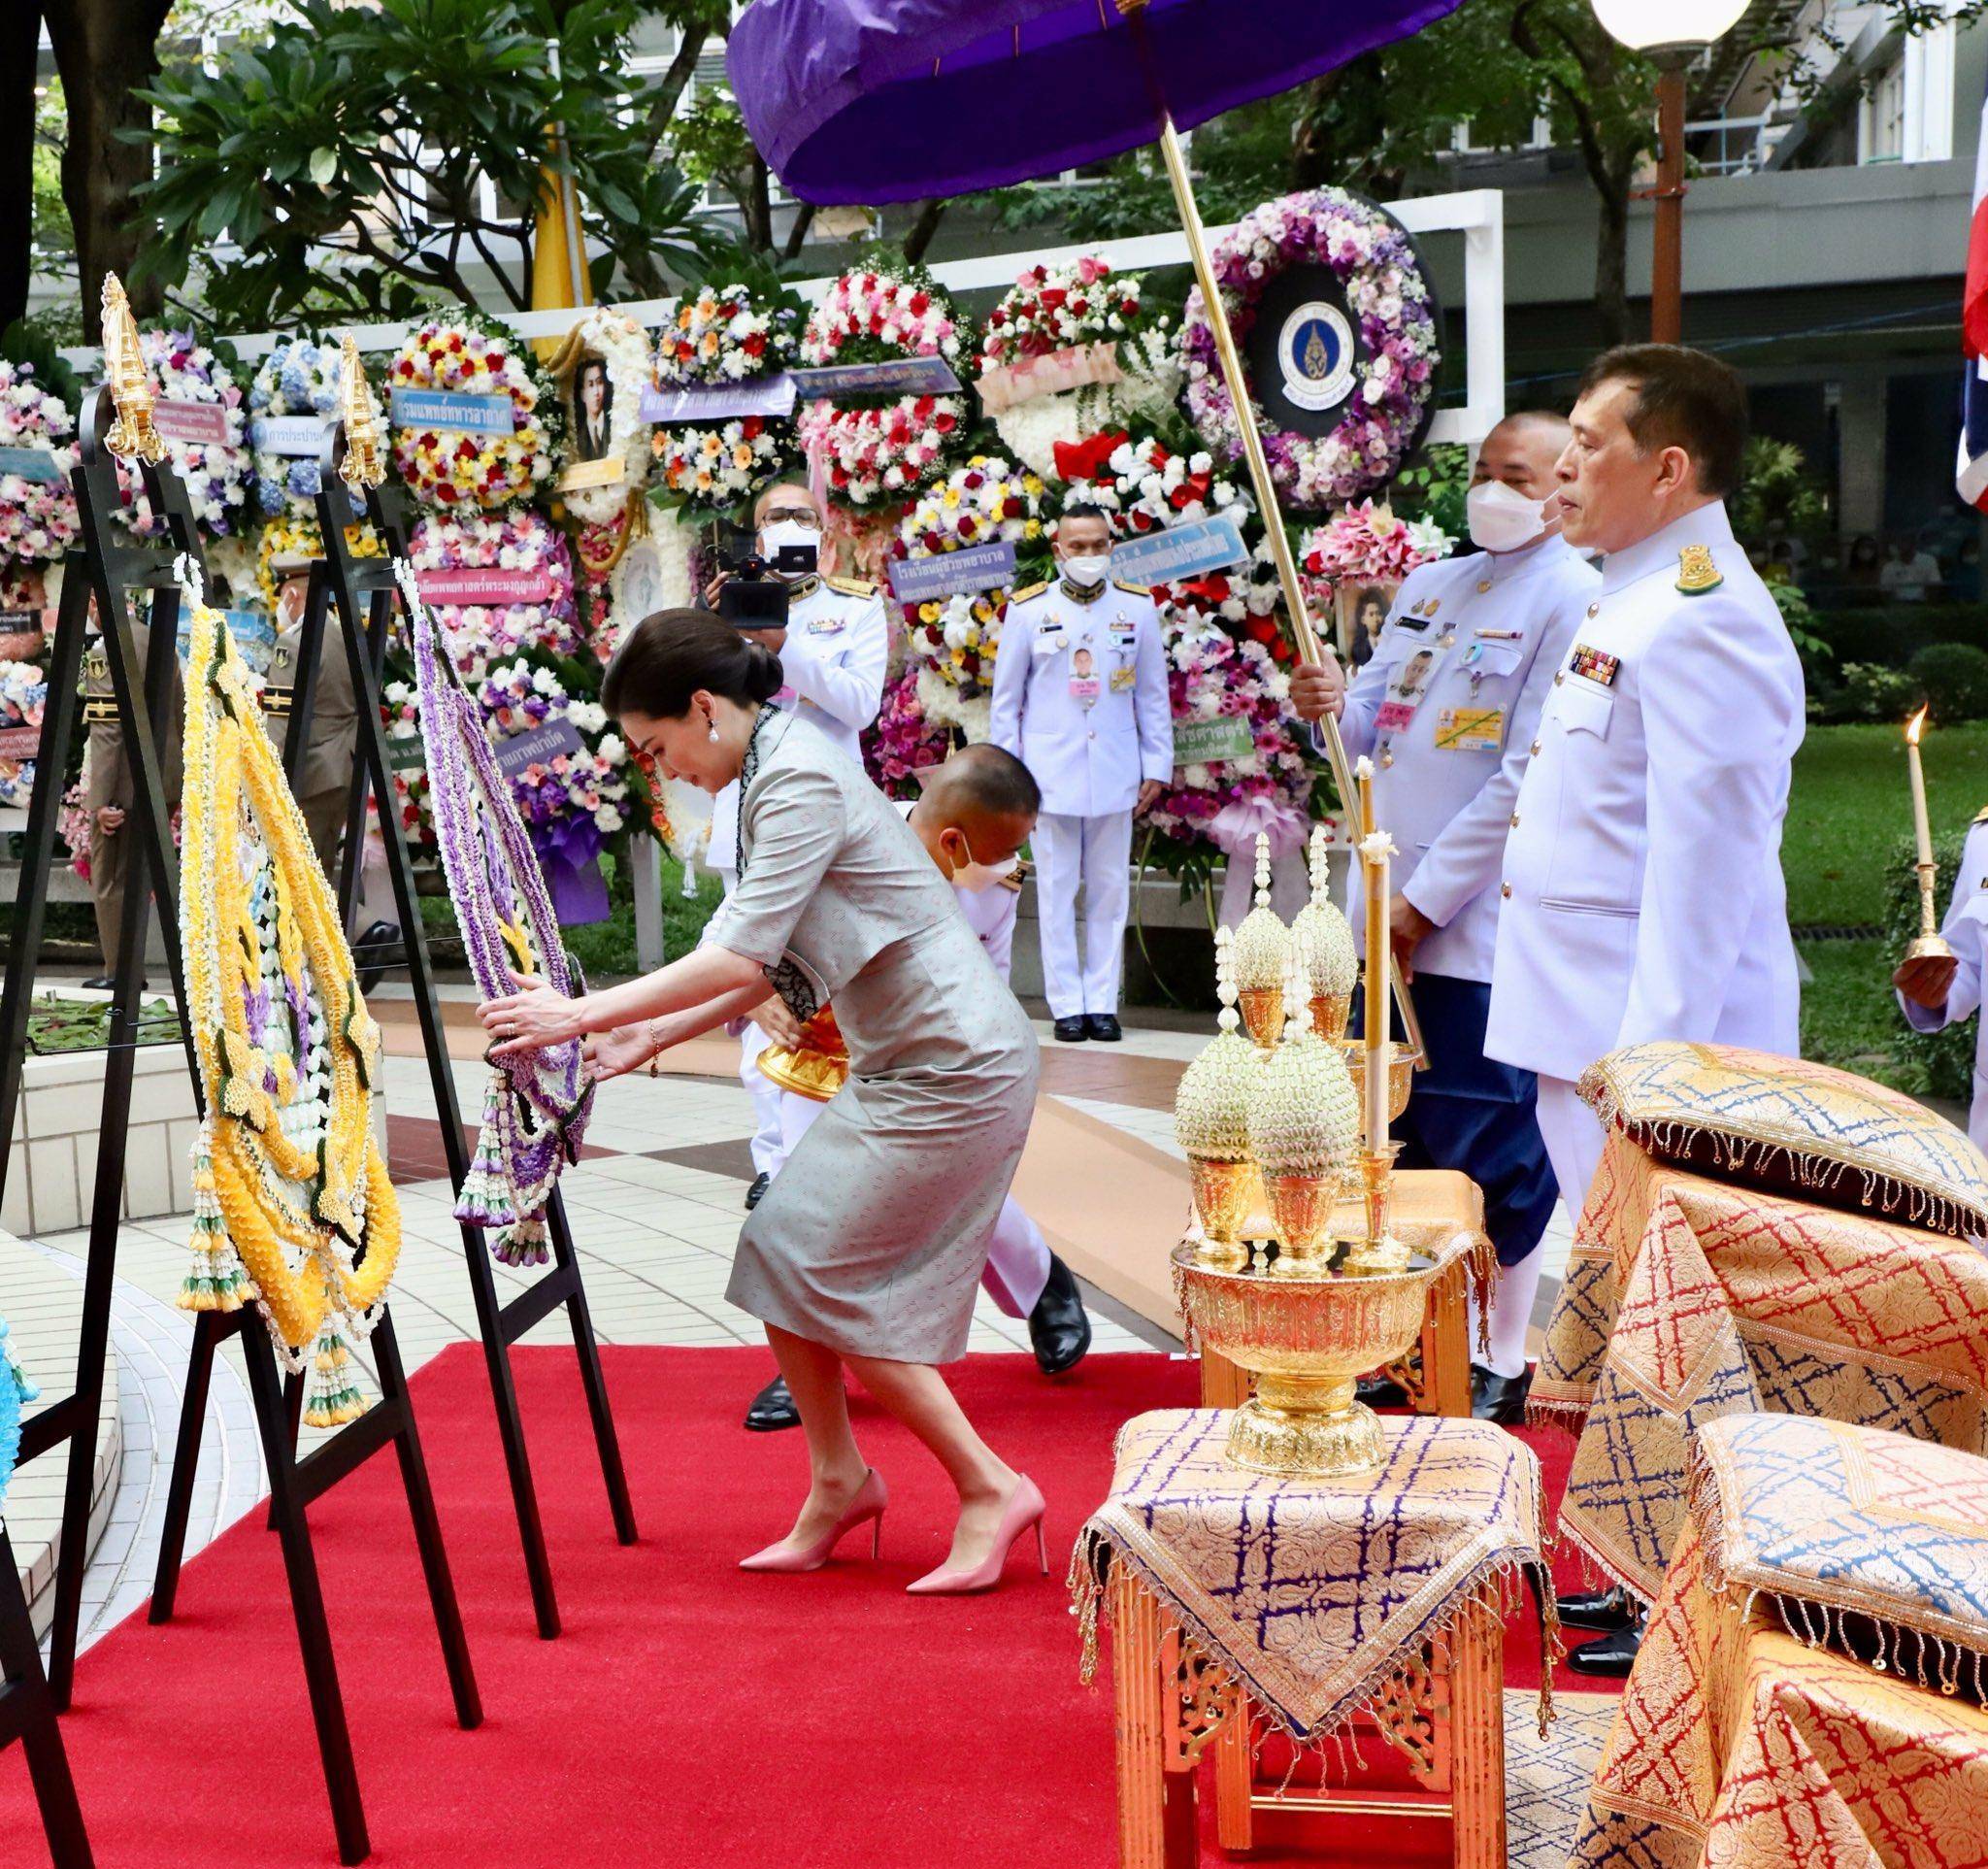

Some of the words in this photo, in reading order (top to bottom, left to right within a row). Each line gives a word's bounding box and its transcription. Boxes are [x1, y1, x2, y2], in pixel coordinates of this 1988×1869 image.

[894, 550, 1006, 580] โรงเรียนผู้ช่วยพยาบาล
